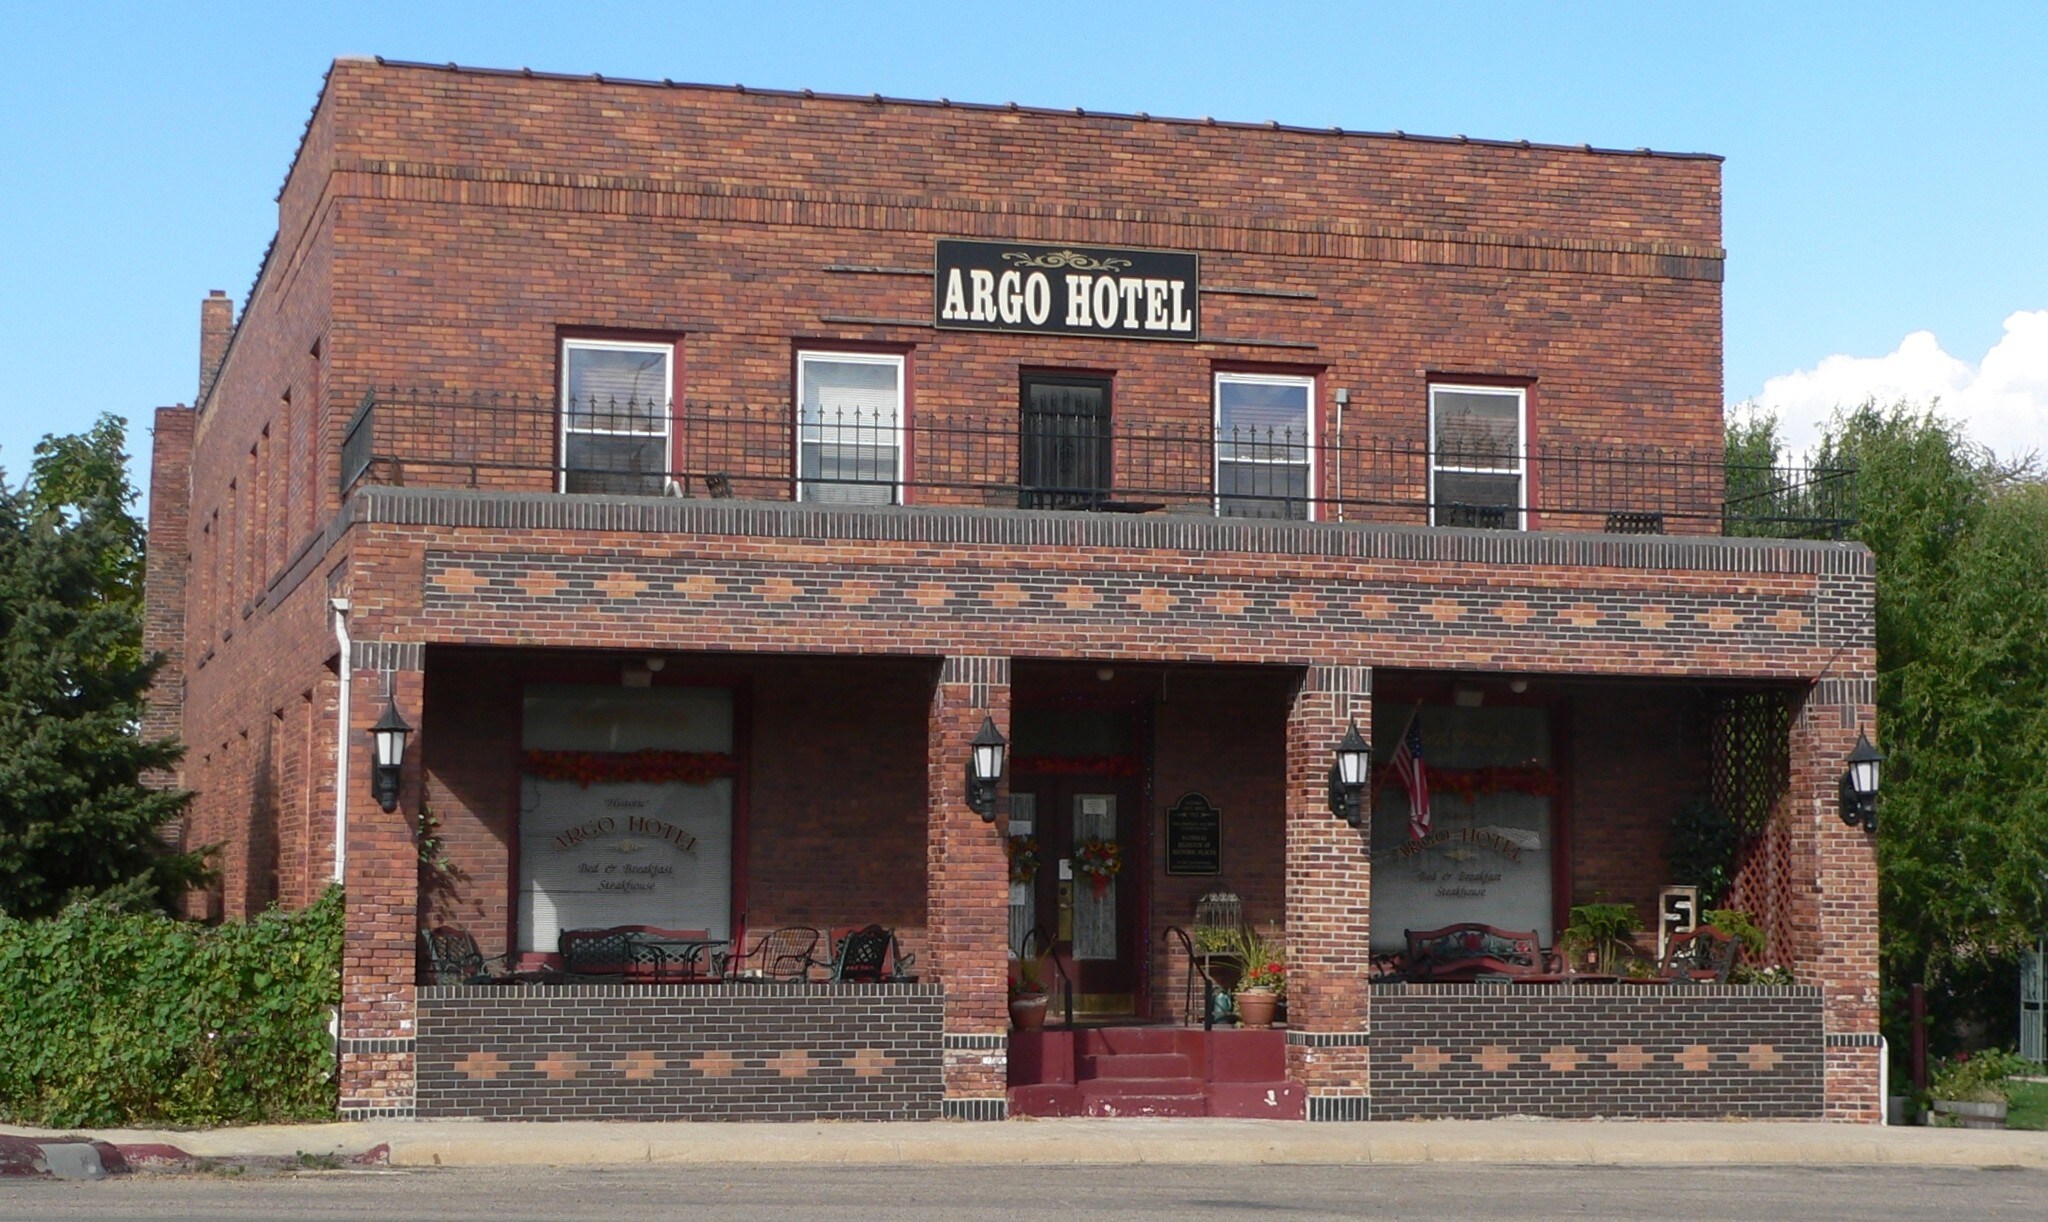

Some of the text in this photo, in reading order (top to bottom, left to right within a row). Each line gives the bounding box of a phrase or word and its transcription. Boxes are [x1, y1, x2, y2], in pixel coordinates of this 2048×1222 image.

[942, 268, 1192, 331] ARGO HOTEL
[553, 815, 699, 854] ARGO HOTEL
[578, 863, 673, 878] Bed & Breakfast
[597, 880, 656, 891] Steakhouse
